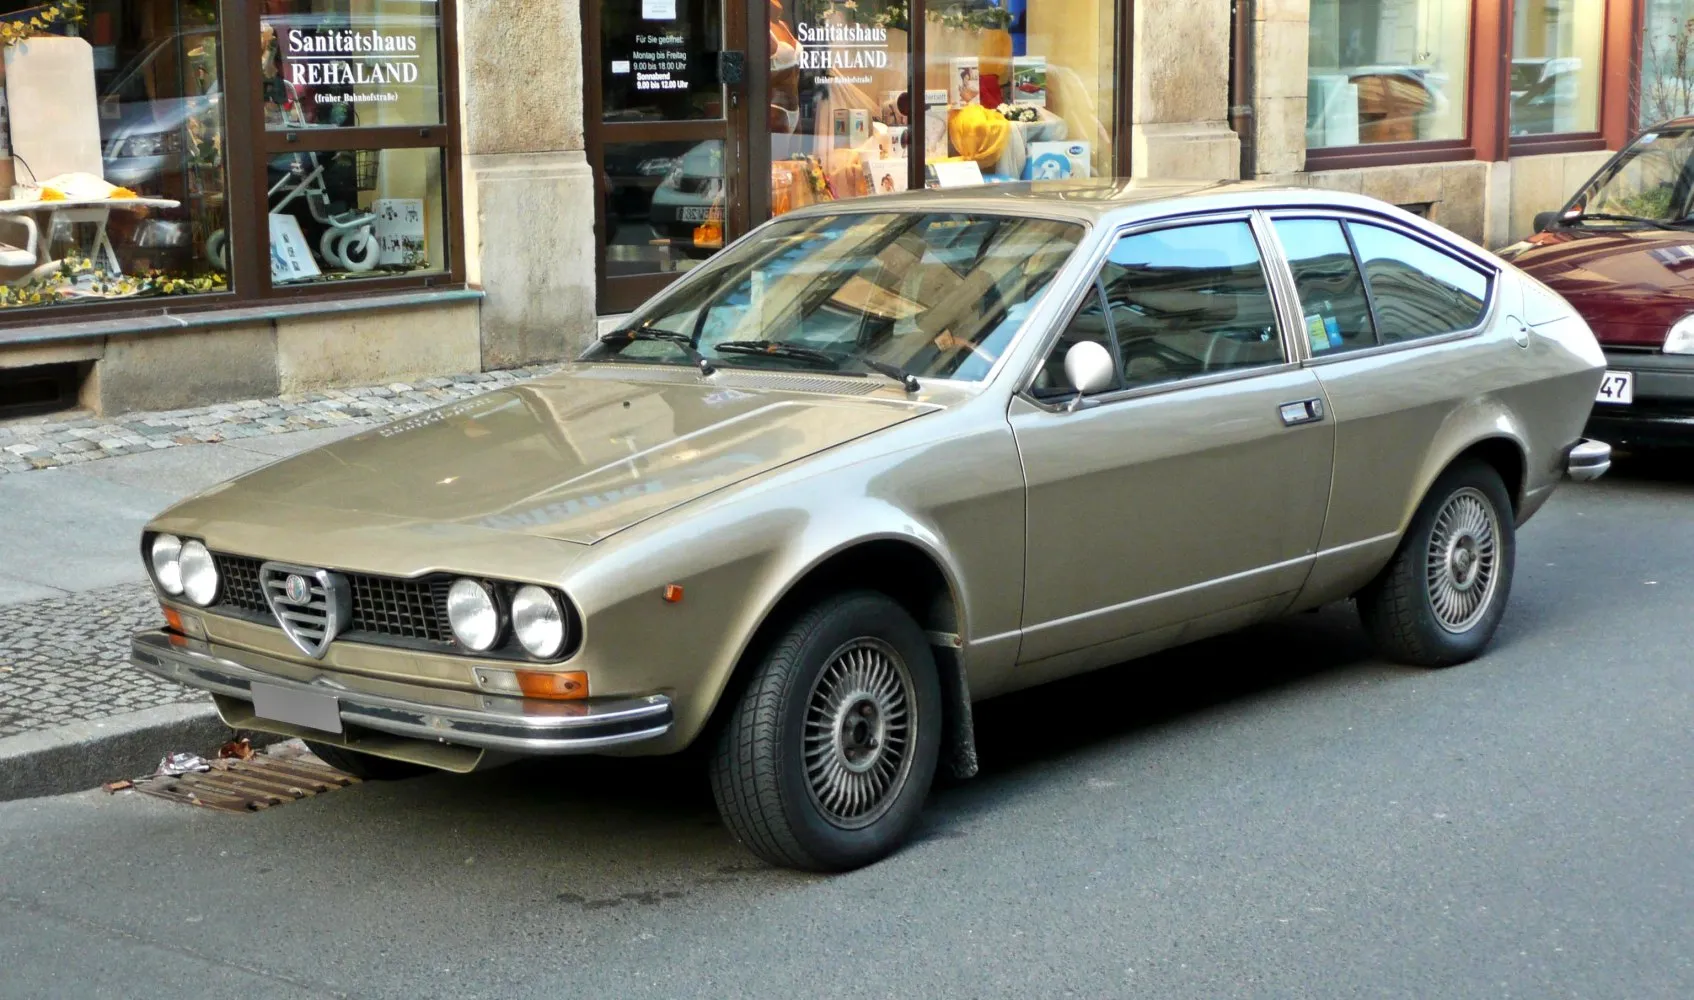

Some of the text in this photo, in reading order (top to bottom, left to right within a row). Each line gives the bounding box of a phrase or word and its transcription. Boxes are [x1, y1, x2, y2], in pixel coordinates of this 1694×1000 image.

[798, 22, 887, 42] Sanitätshaus
[289, 29, 416, 52] Sanitätshaus
[636, 34, 646, 43] Für
[648, 35, 658, 43] Sie
[633, 51, 686, 61] Montag bis Freitag
[799, 50, 887, 69] REHALAND
[647, 61, 657, 70] bis
[675, 62, 687, 70] Uhr
[291, 62, 418, 85] REHALAND
[636, 72, 670, 80] Sonnabend
[650, 81, 660, 90] bis
[677, 80, 689, 89] Uhr
[314, 92, 398, 104] (früher Bahnhofstraße)
[1599, 377, 1627, 398] 47
